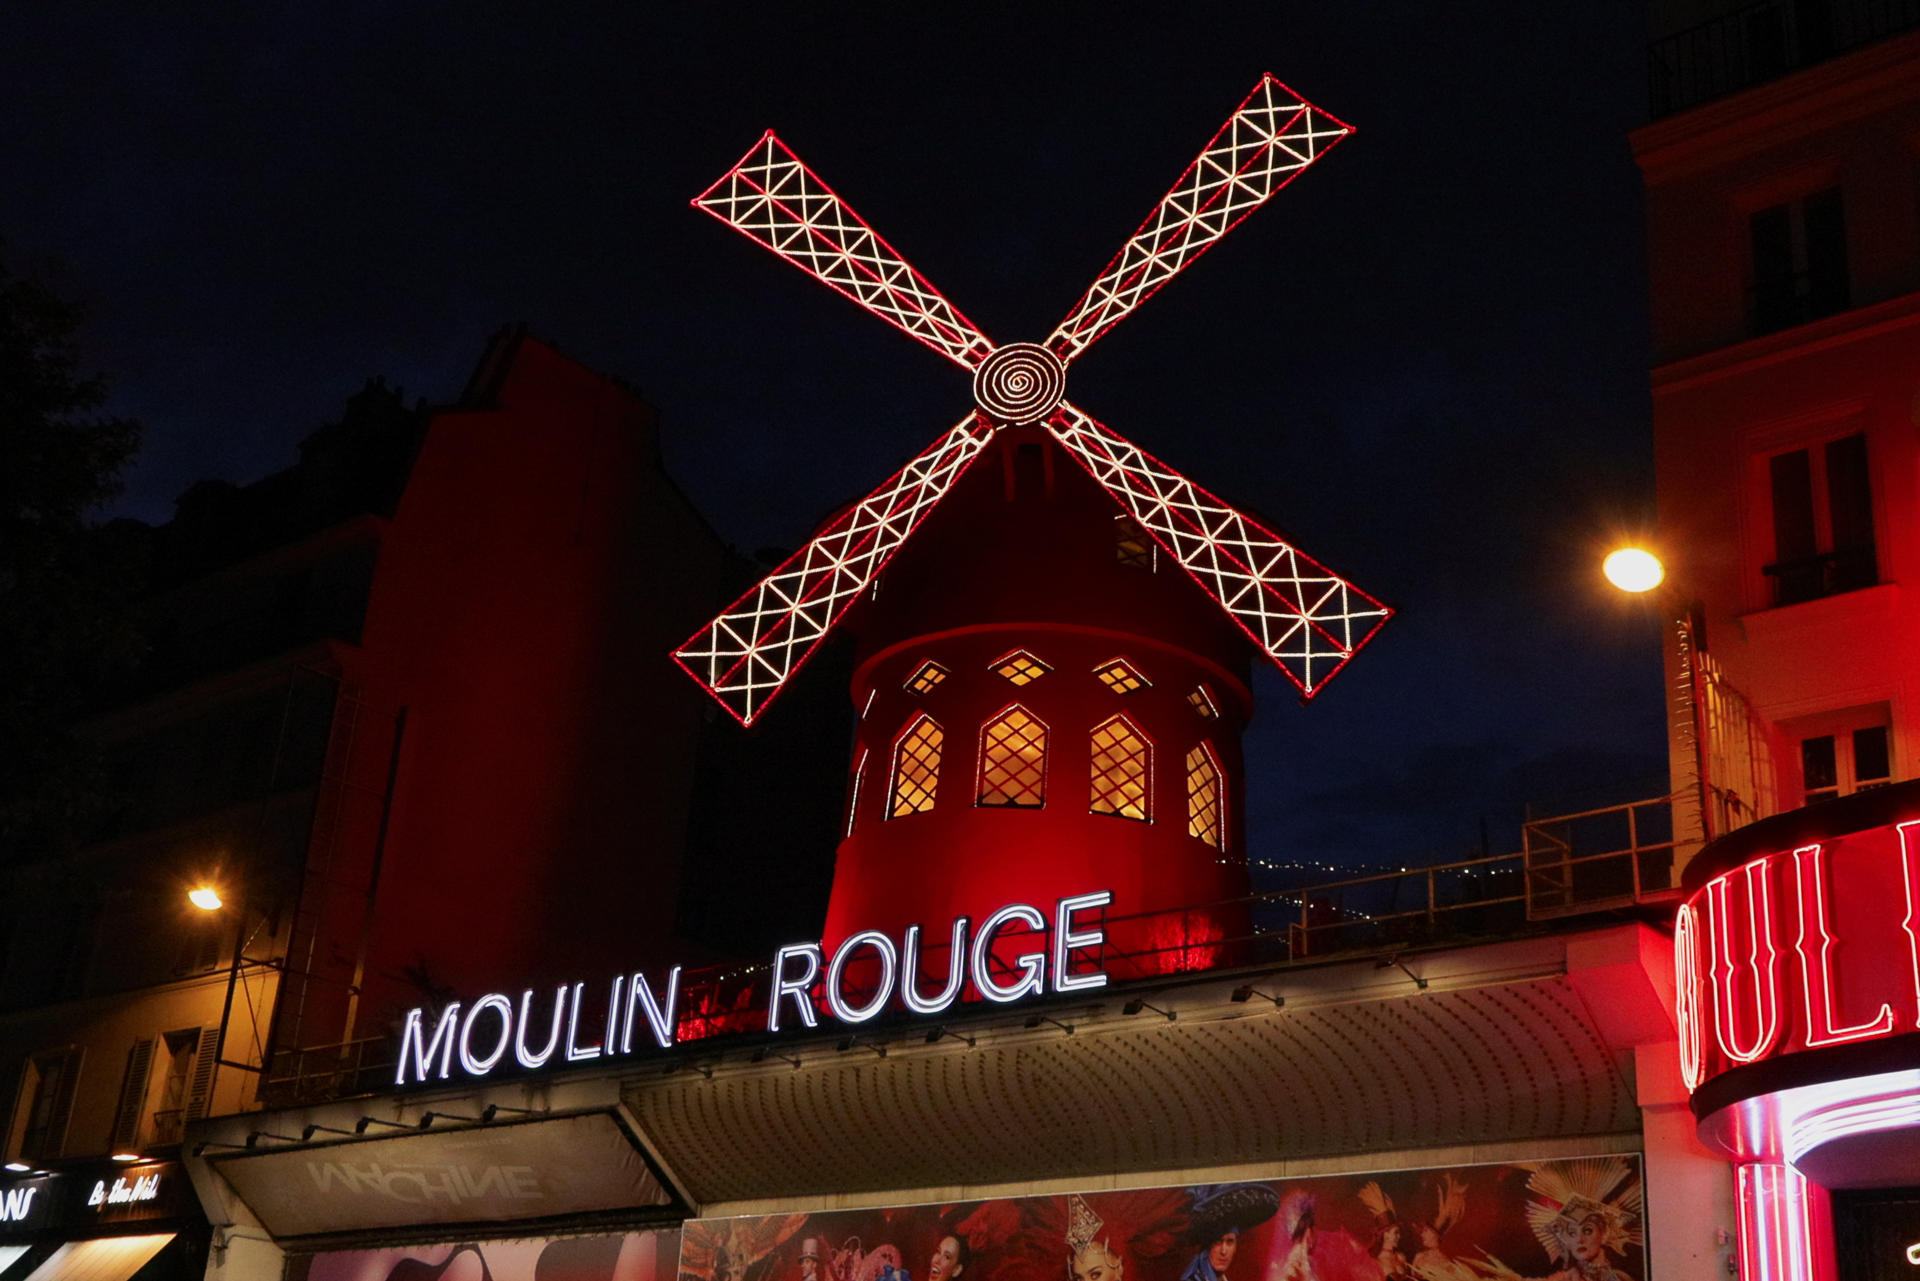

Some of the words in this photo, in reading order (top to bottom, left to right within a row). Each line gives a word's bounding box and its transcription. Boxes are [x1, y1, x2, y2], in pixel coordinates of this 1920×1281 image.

[394, 964, 682, 1087] MOULIN
[766, 889, 1113, 1033] ROUGE
[1674, 818, 1920, 1094] OUL
